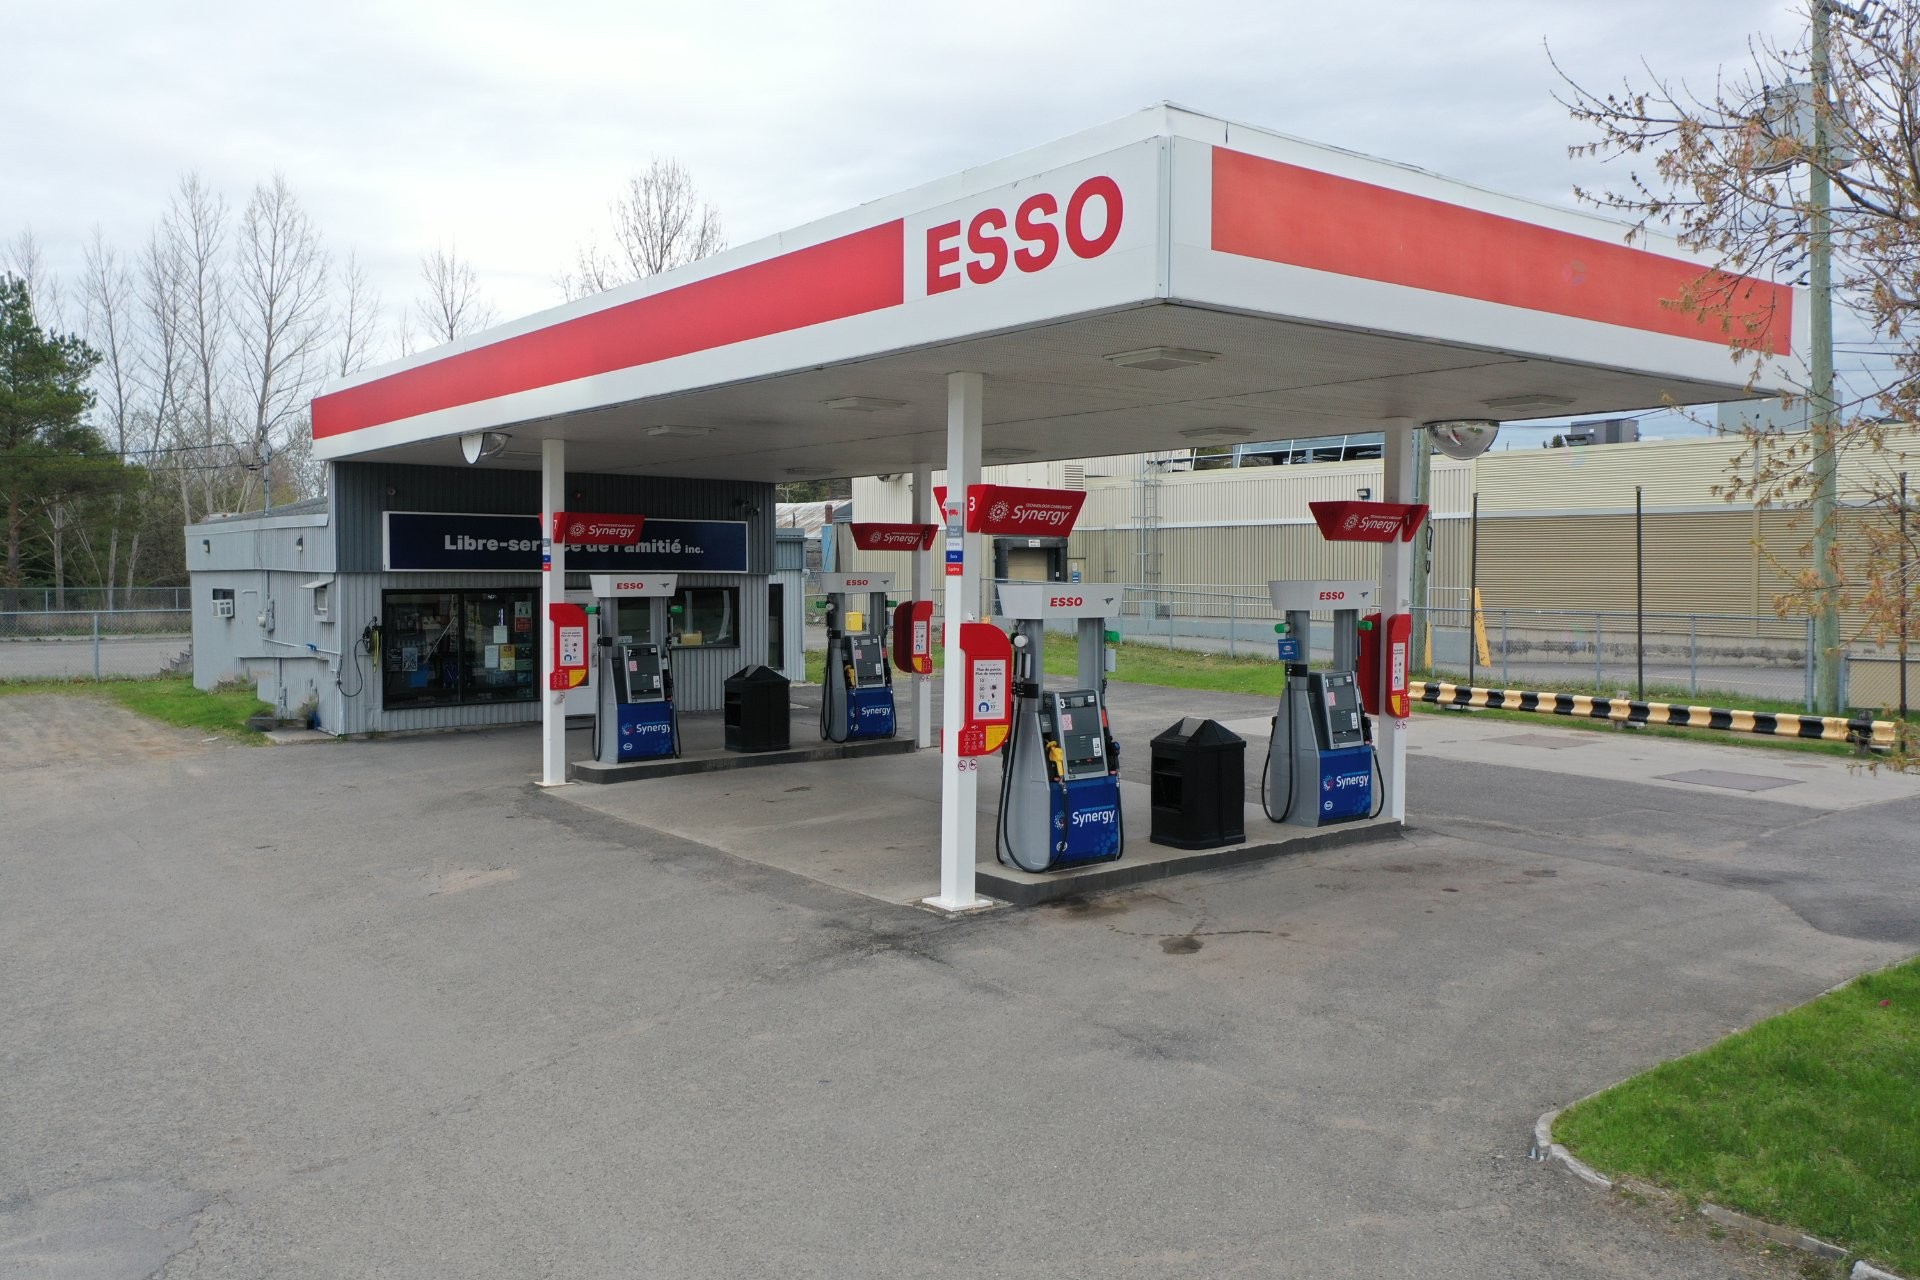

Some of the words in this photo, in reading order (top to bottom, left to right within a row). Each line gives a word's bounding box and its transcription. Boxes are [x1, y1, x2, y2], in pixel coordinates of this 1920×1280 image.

[926, 175, 1124, 296] ESSO
[968, 496, 976, 512] 3
[1011, 505, 1070, 526] Synergy
[1359, 517, 1400, 533] Synergy
[588, 525, 635, 538] Synergy
[883, 532, 919, 545] Synergy
[684, 545, 705, 554] inc.
[616, 582, 644, 590] ESSO
[1319, 591, 1345, 600] ESSO
[1050, 597, 1083, 607] ESSO
[627, 649, 632, 657] 7
[1060, 698, 1066, 709] 3
[861, 706, 891, 717] Synergy
[636, 723, 671, 735] Synergy
[1336, 774, 1369, 790] Synergy
[1072, 810, 1116, 828] Synergy
